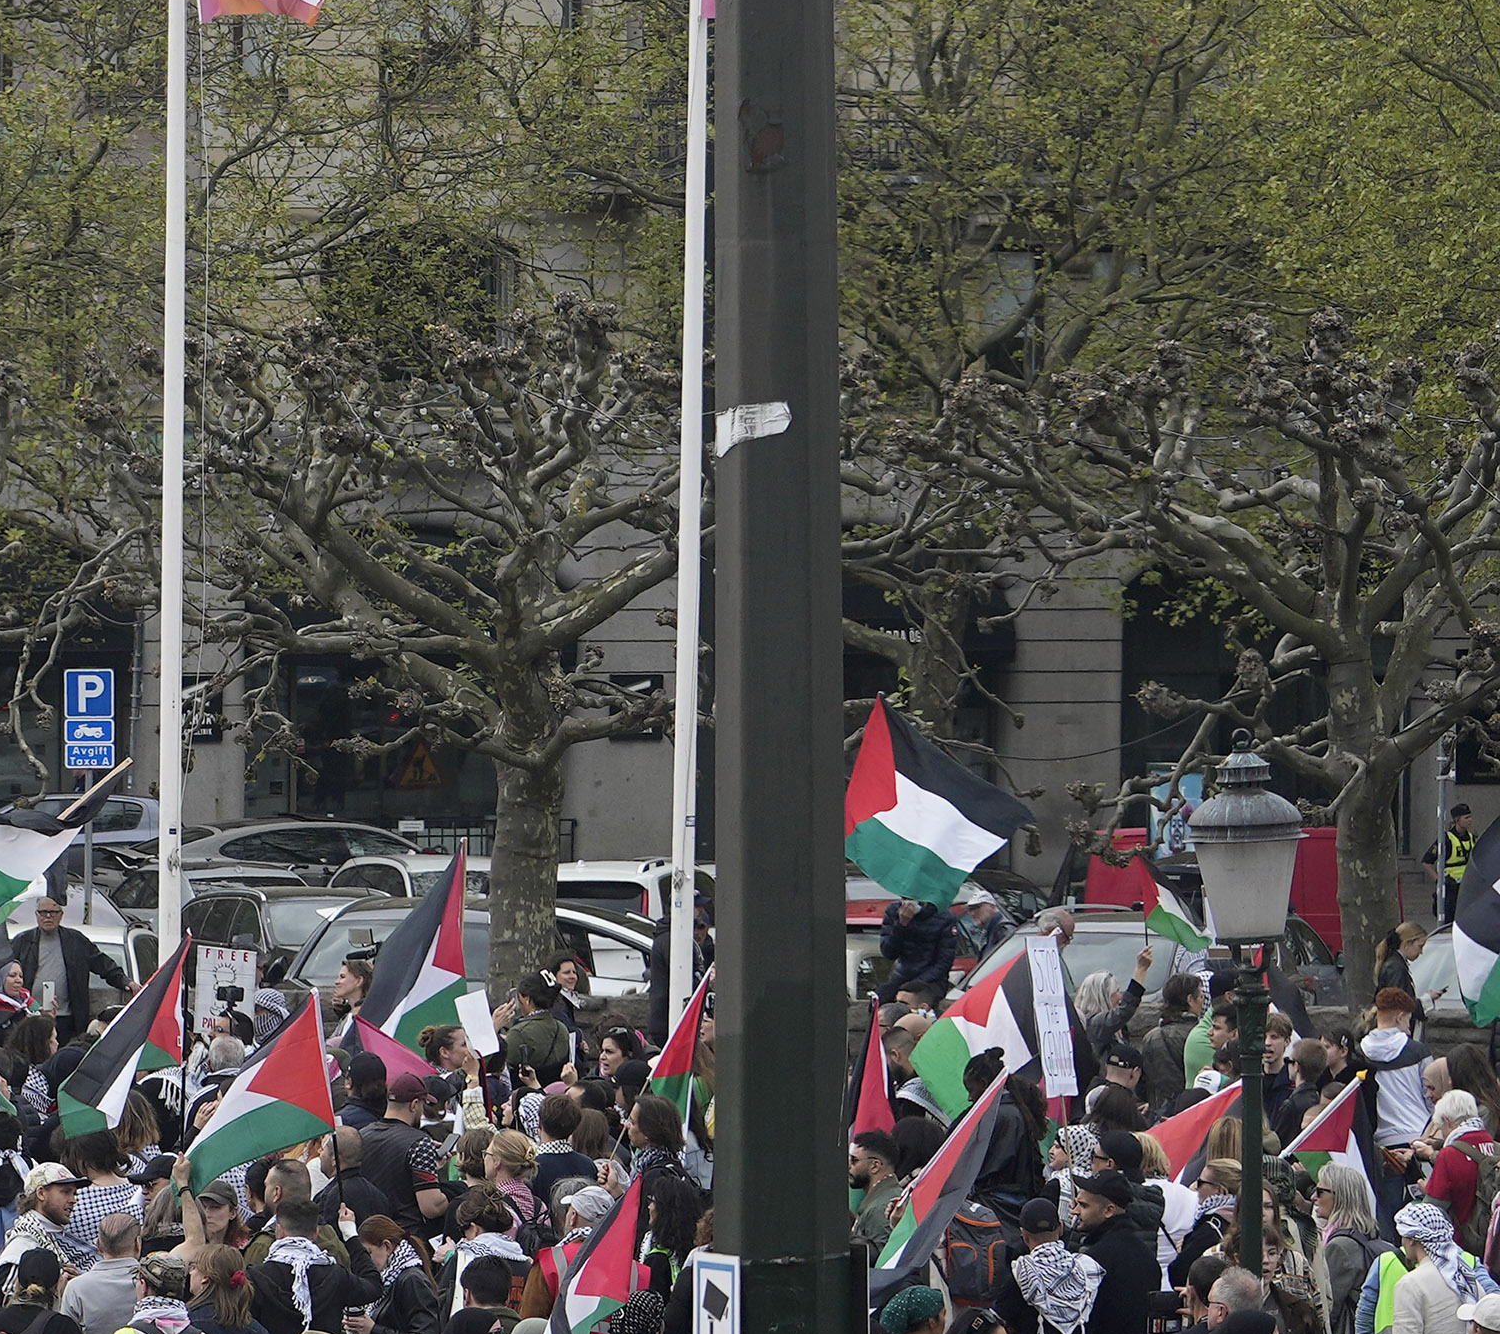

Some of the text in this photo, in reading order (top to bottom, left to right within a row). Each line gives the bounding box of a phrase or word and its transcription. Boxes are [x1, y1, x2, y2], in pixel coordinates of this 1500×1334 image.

[77, 674, 105, 713] P
[70, 757, 110, 766] Taxa A
[72, 746, 108, 758] Avgift
[205, 948, 249, 964] FREE
[1033, 949, 1059, 995] STOP
[1043, 1002, 1060, 1025] THE
